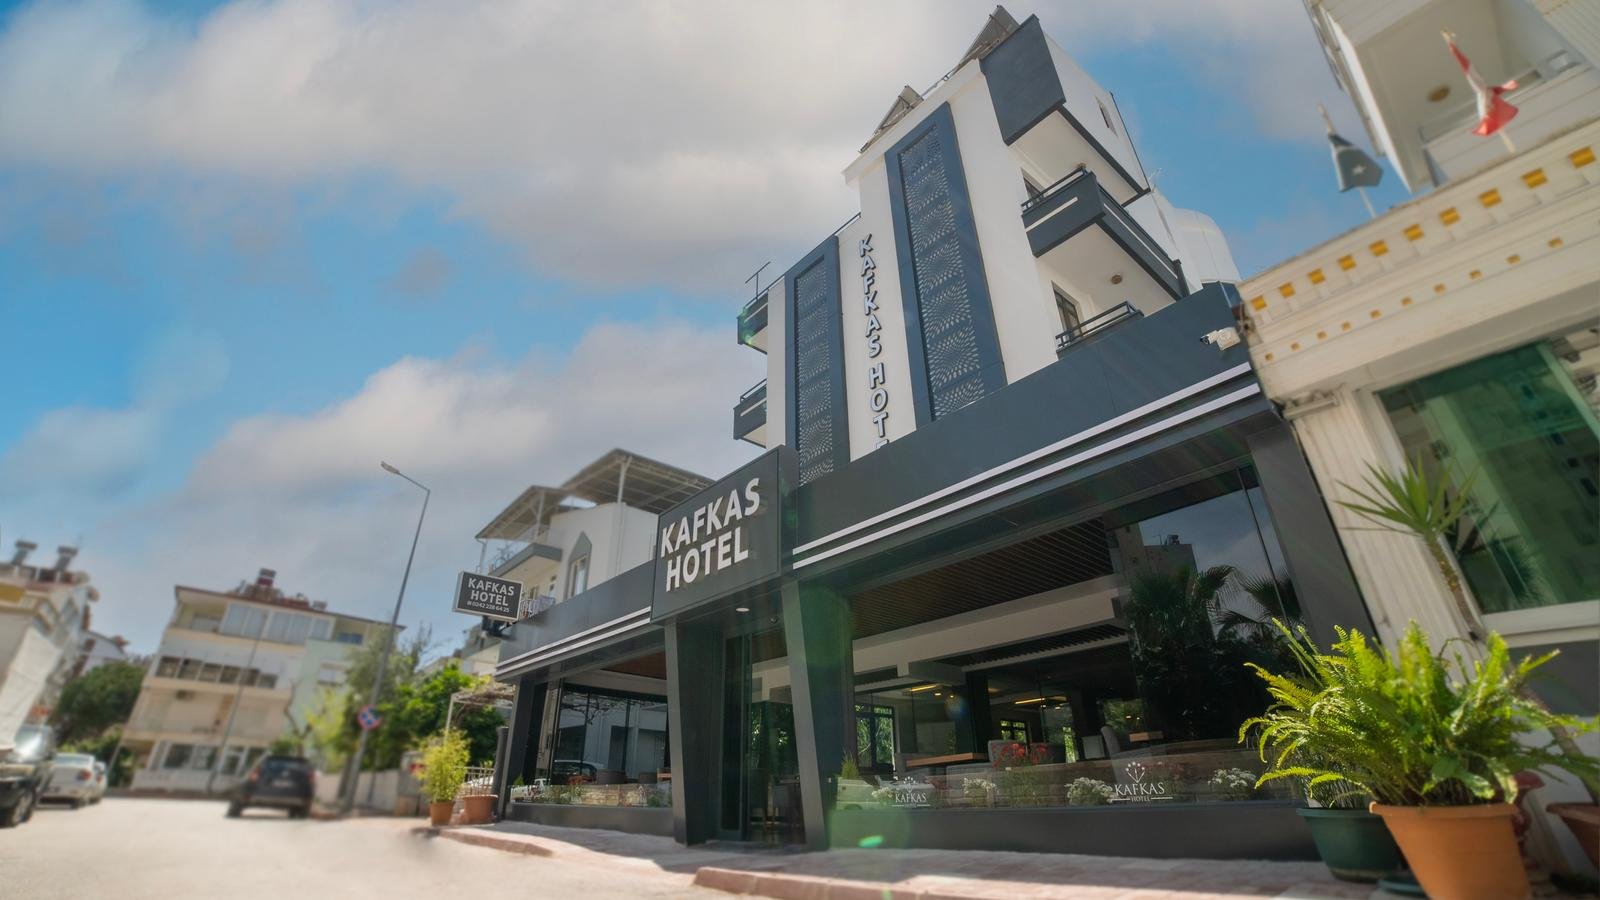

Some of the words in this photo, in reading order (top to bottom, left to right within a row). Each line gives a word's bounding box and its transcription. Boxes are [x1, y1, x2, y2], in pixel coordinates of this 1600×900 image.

[858, 233, 883, 358] KAFKAS
[661, 478, 760, 558] KAFKAS
[666, 526, 749, 592] HOTEL
[468, 578, 514, 596] KAFKAS
[470, 589, 508, 606] HOTEL
[895, 792, 927, 803] KAFKAS
[1114, 782, 1165, 796] KAFKAS
